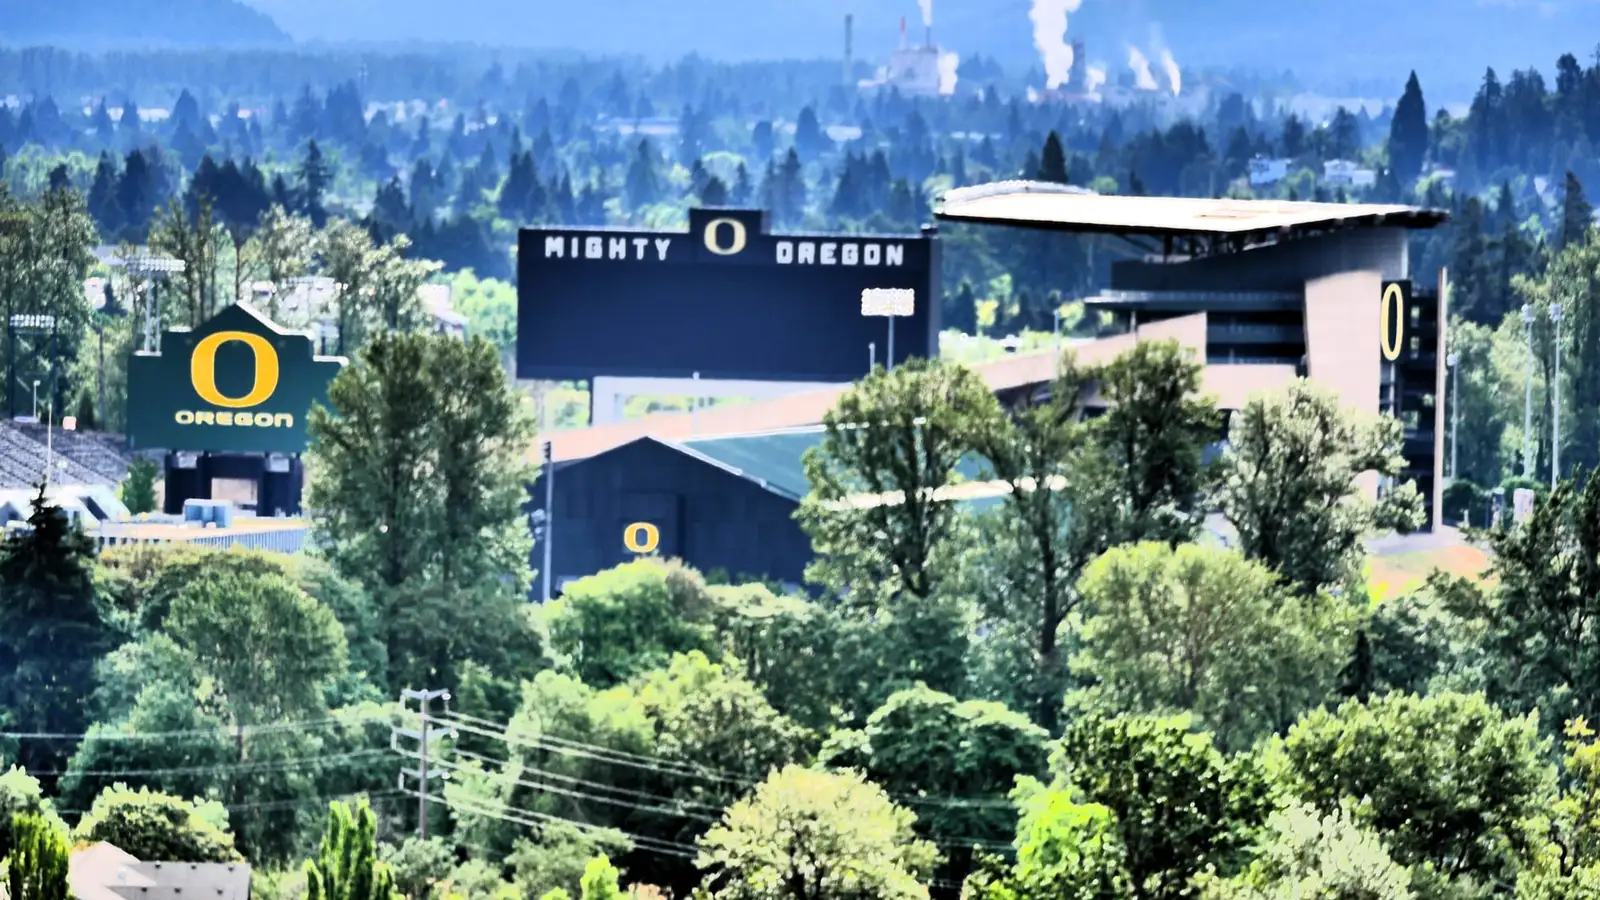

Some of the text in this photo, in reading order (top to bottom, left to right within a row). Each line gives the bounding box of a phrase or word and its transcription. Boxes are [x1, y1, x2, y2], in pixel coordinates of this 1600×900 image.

[545, 218, 904, 266] MIGHTY O OREGON
[191, 331, 279, 408] O
[175, 410, 294, 428] OREGON
[624, 522, 660, 553] O
